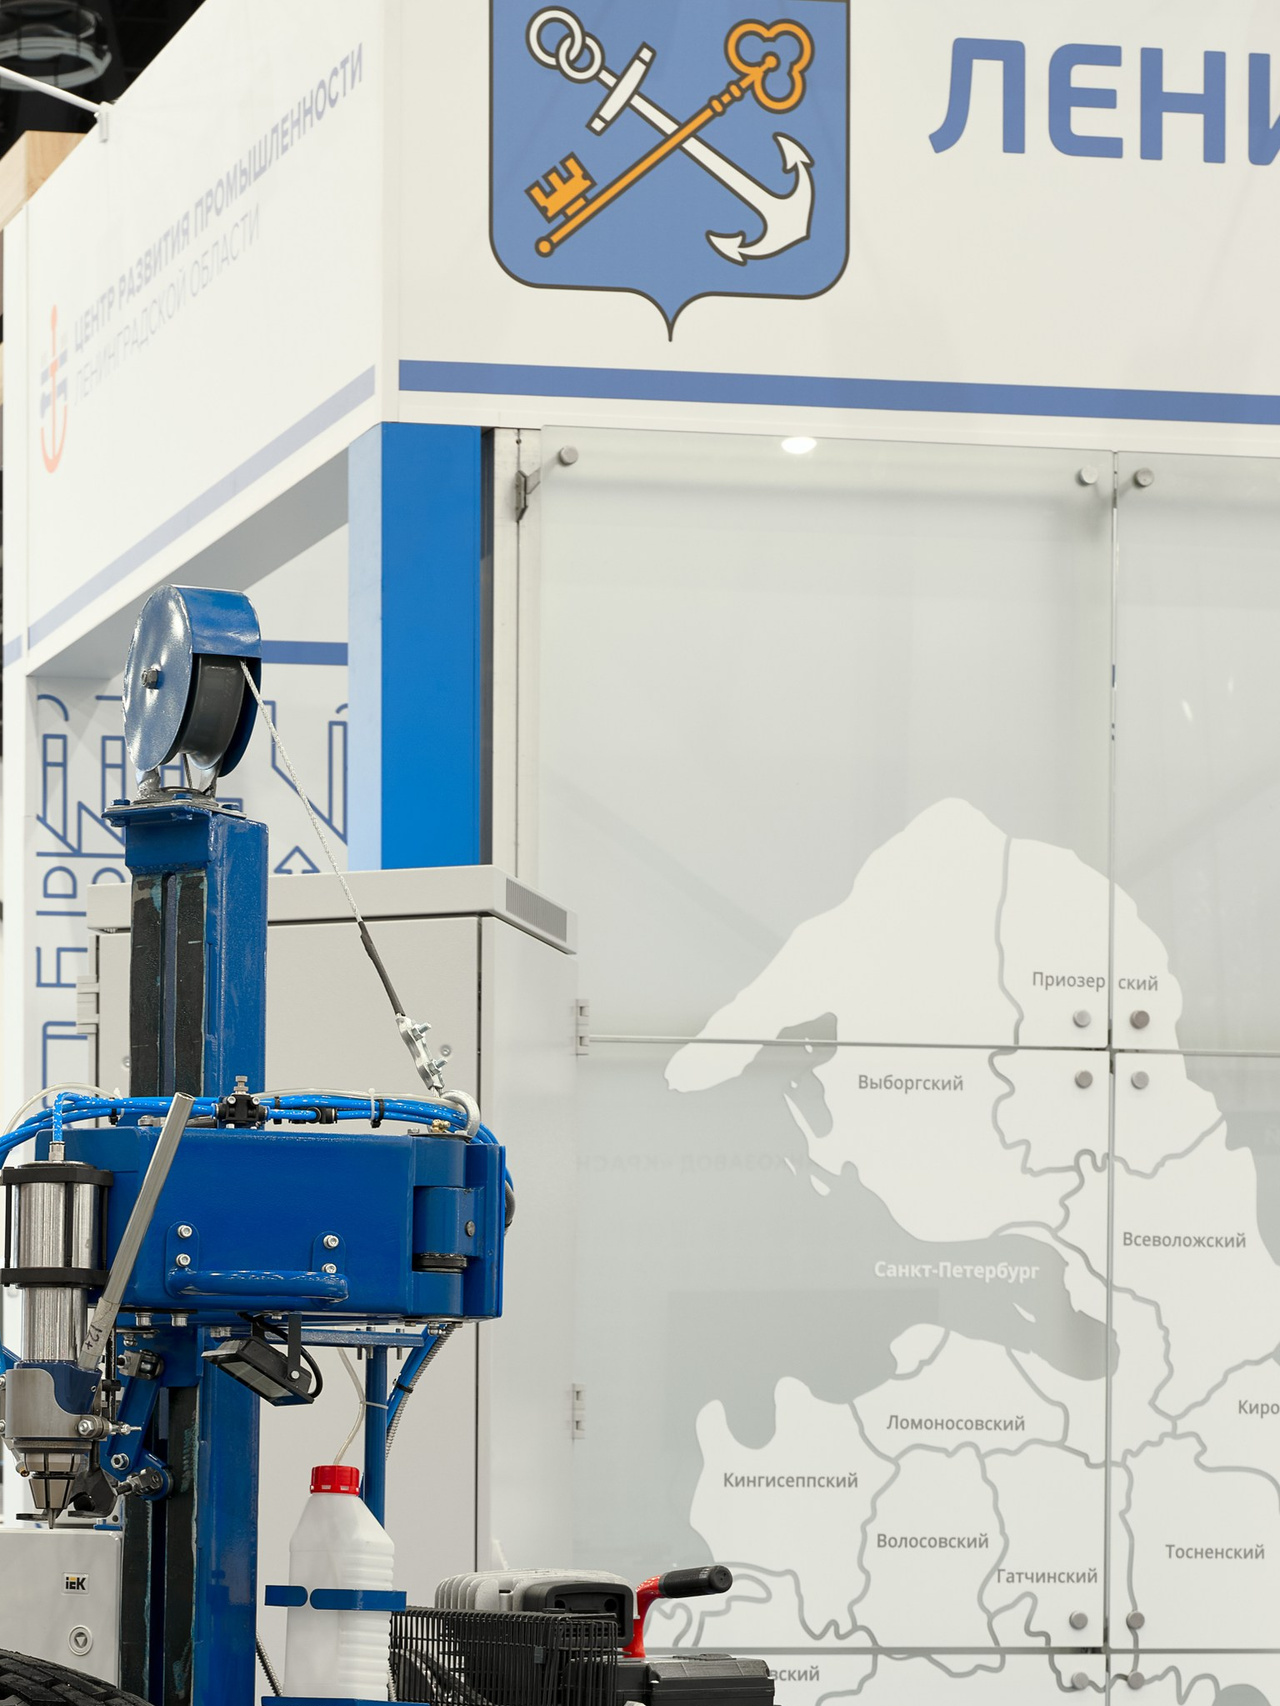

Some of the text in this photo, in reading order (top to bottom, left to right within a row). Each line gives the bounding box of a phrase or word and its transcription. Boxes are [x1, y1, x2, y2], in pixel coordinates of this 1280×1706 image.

[73, 42, 363, 352] ЦЕНТР РАЗВИТИЯ ПРОМЫШЛЕННОСТИ
[74, 202, 260, 406] ЛЕНИНГРАДСКОЙ ОБЛАСТИ
[857, 1074, 964, 1095] Выборгский
[1123, 1231, 1246, 1248] Всеволожский
[874, 1260, 1041, 1283] Санкт-Петербург
[886, 1414, 1026, 1433] Ломоносовский
[723, 1471, 859, 1491] Кингисеппский
[876, 1532, 990, 1550] Волосовский
[1165, 1543, 1266, 1561] Тосненский
[996, 1567, 1098, 1585] Гатчинский
